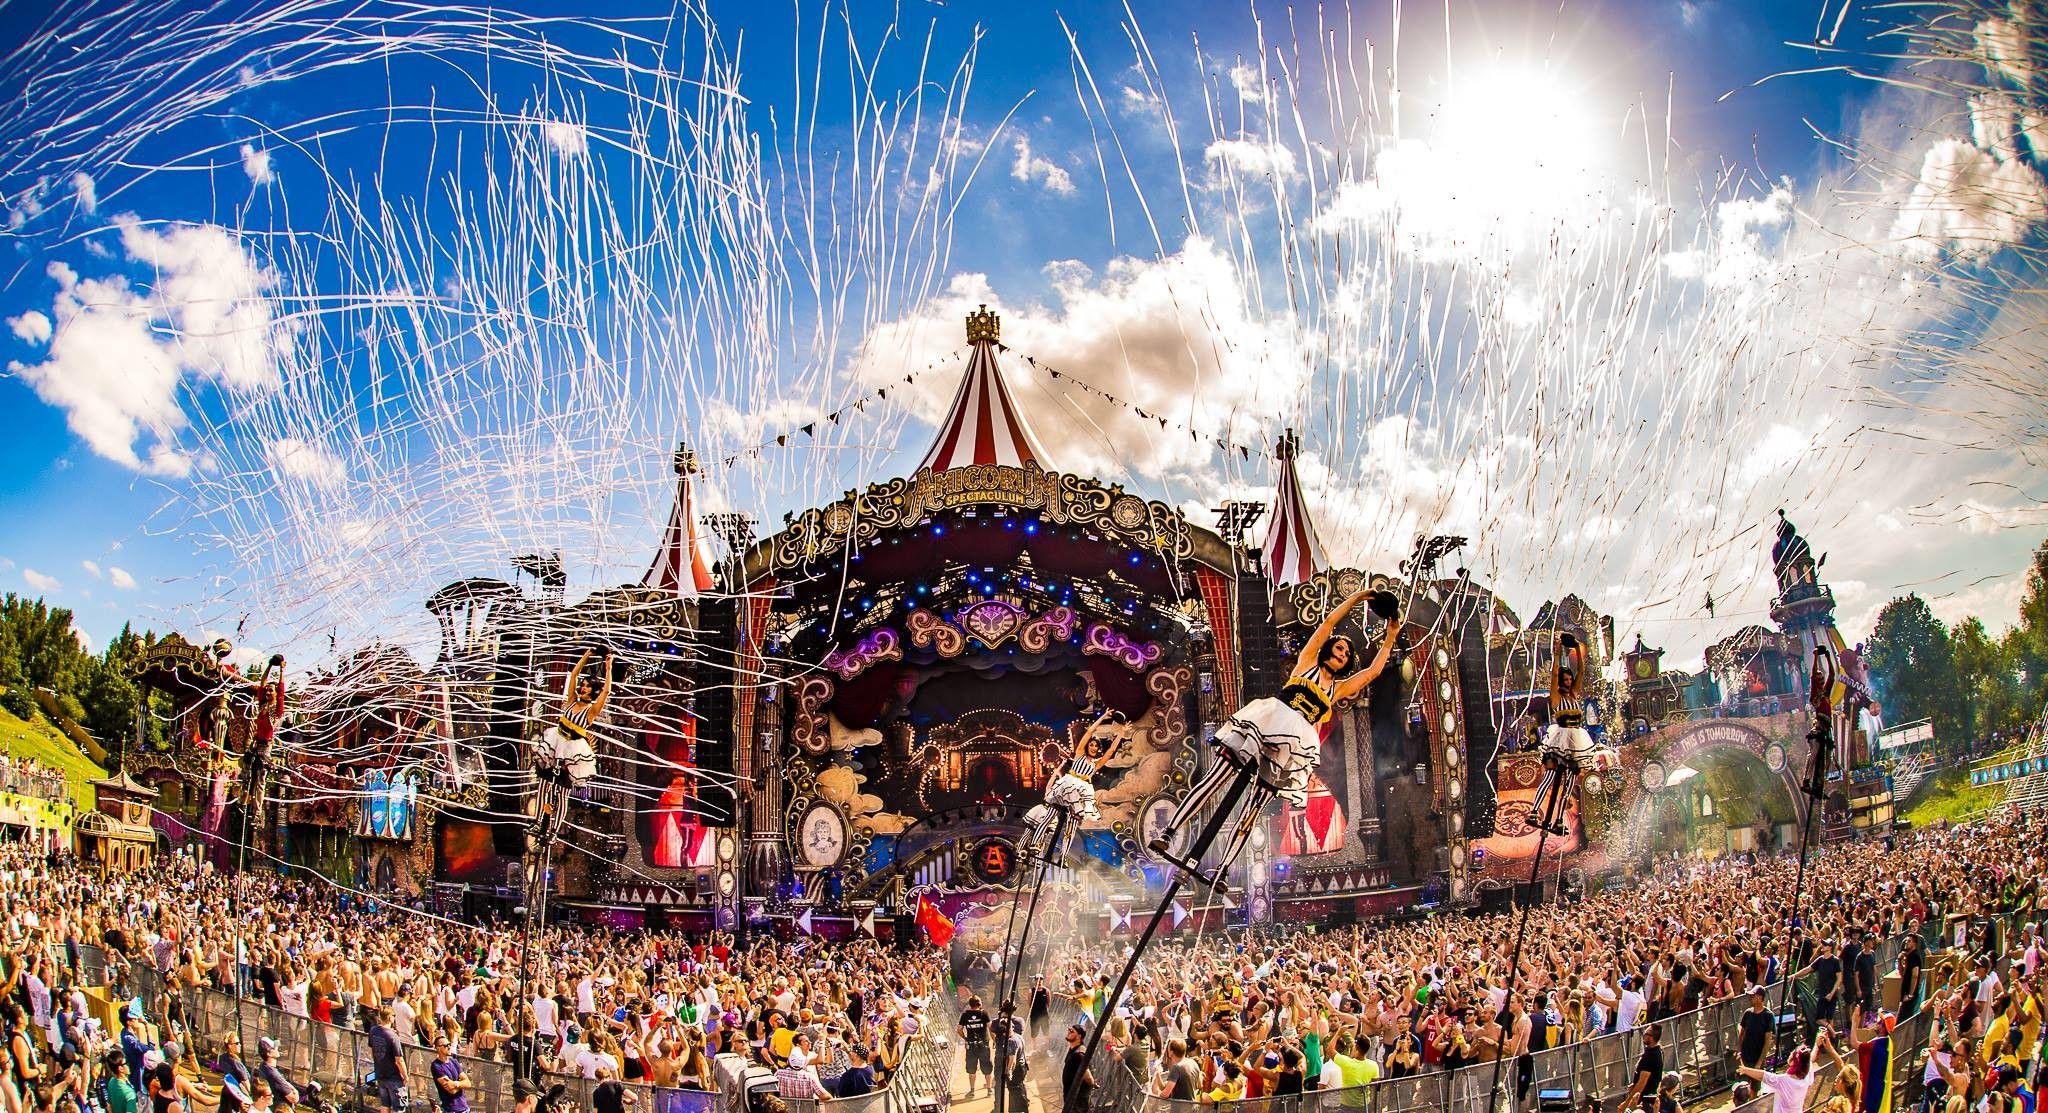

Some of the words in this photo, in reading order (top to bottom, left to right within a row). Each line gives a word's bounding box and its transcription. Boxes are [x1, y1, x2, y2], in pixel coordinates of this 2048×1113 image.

[902, 459, 1067, 527] AMICORUM
[946, 491, 1024, 505] SPECTACULUM
[1680, 734, 1697, 751] THIS
[1698, 729, 1705, 743] IS
[1705, 727, 1749, 744] TOMORROW
